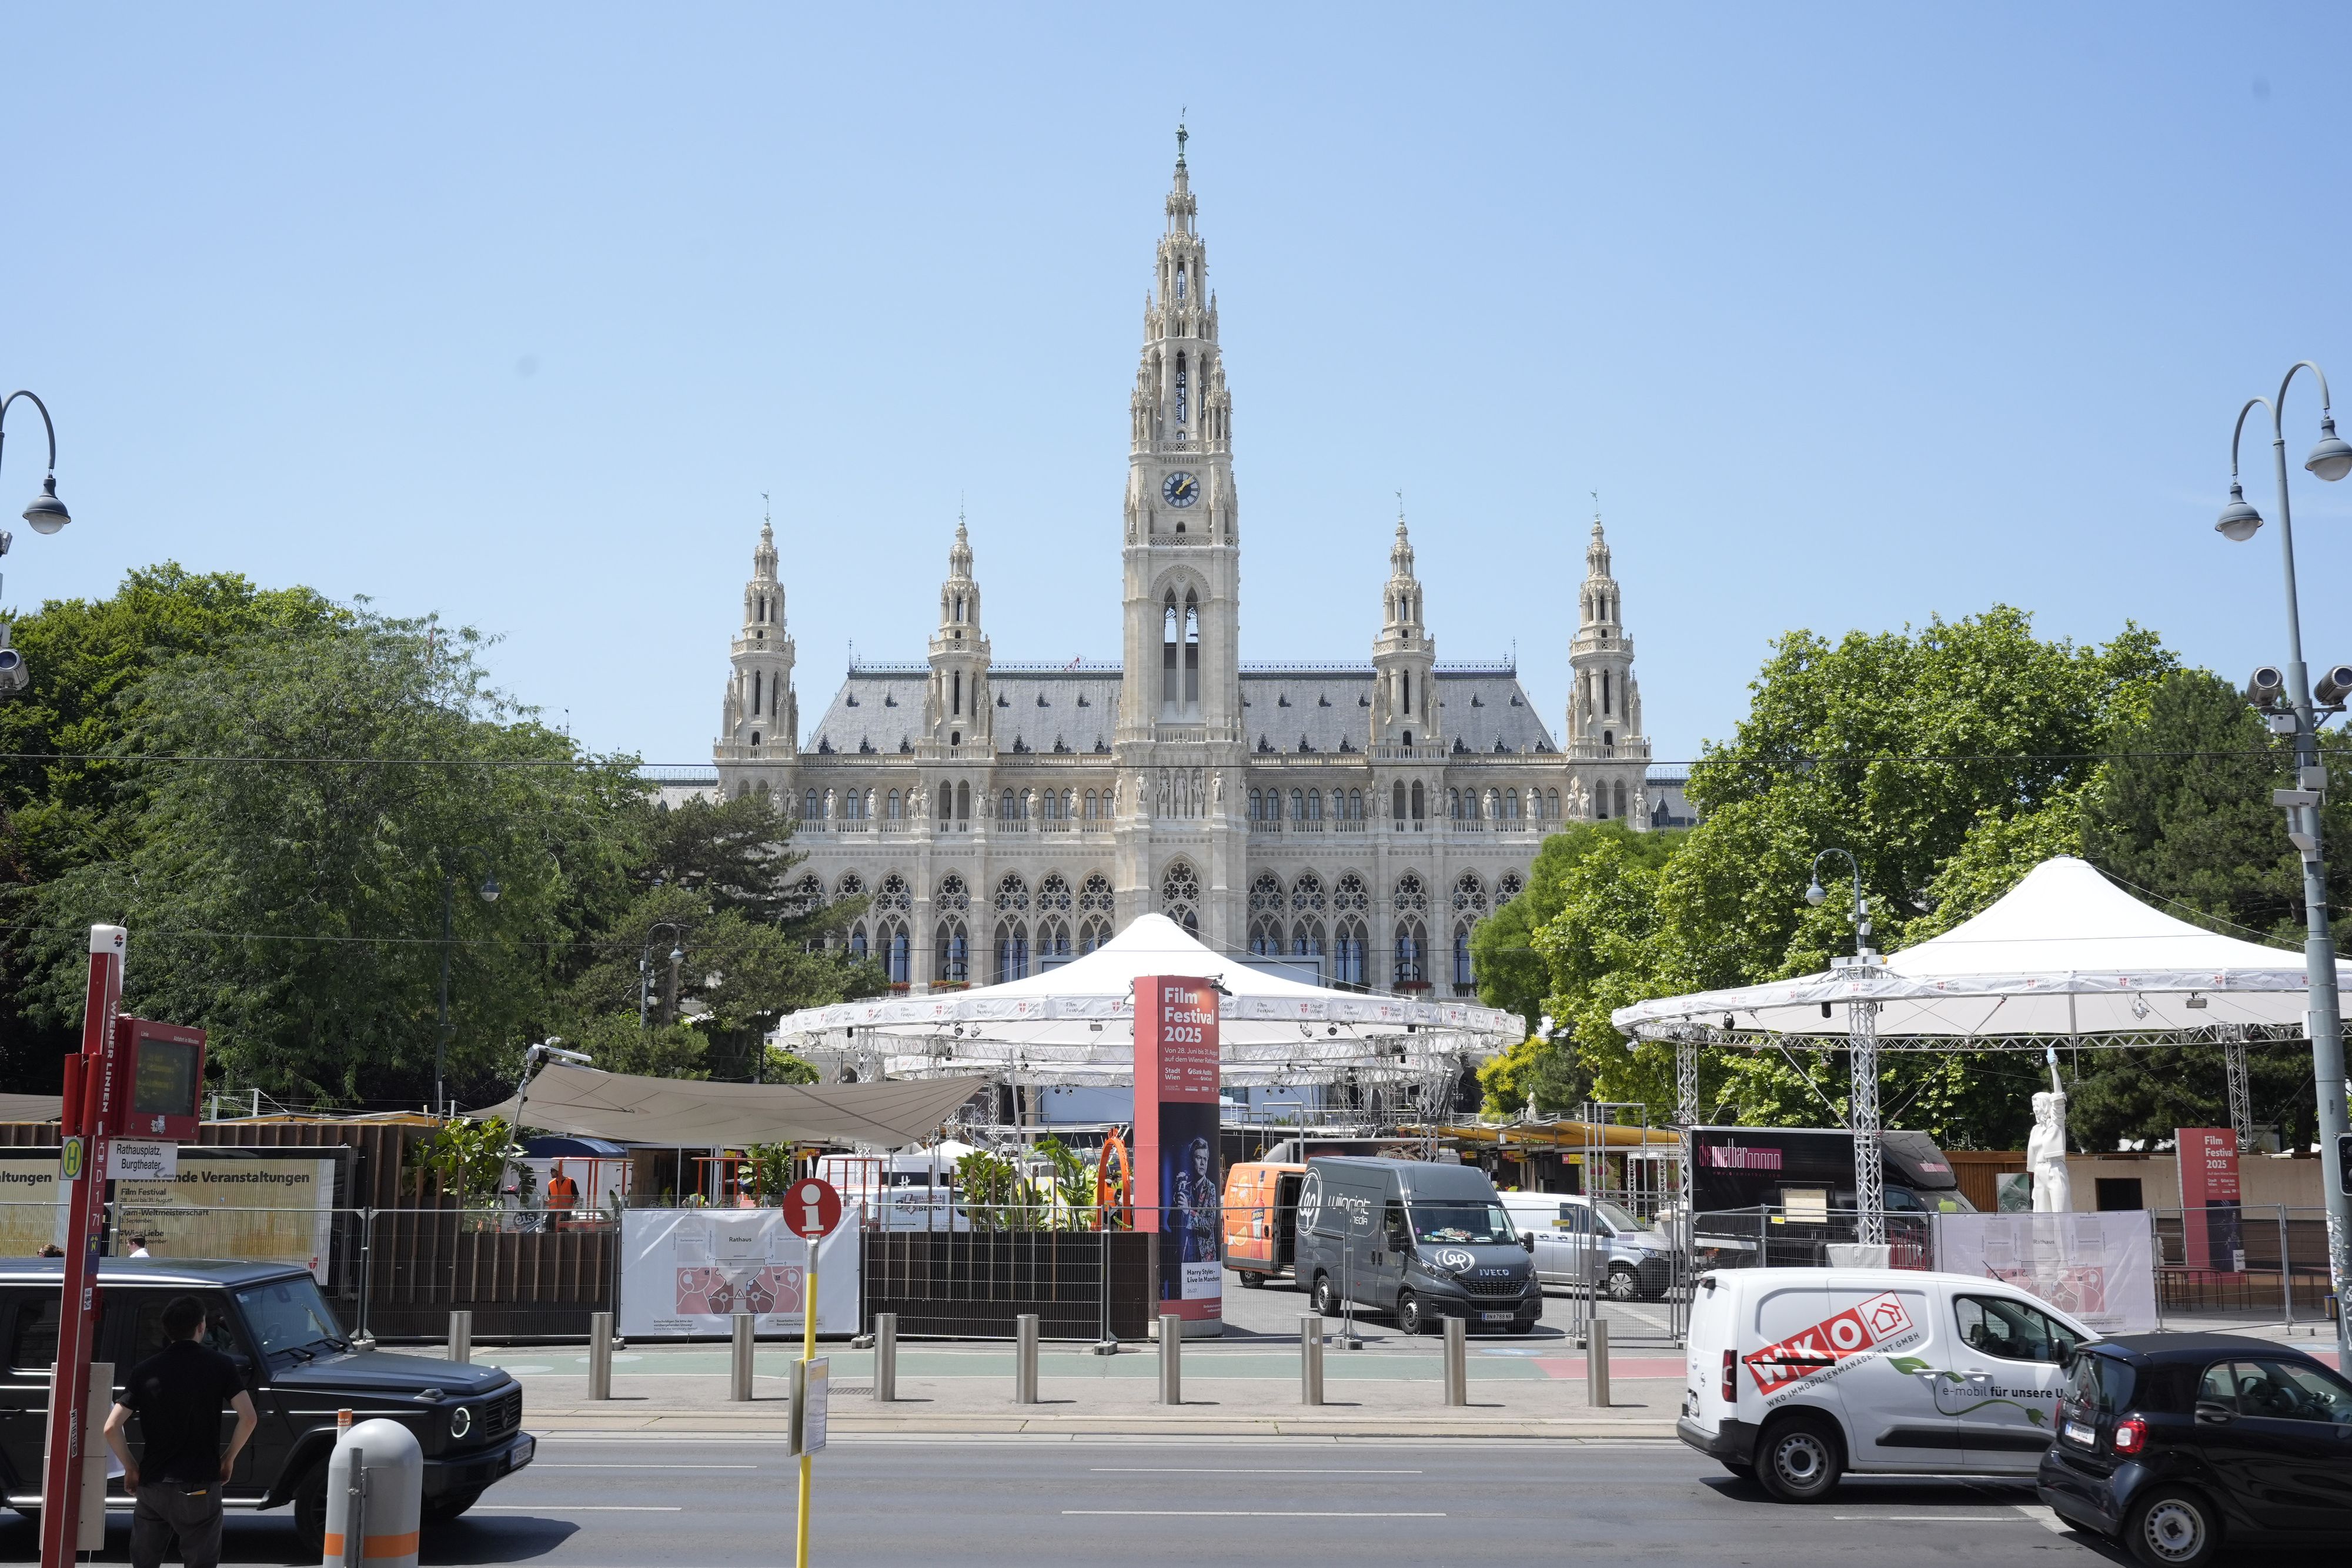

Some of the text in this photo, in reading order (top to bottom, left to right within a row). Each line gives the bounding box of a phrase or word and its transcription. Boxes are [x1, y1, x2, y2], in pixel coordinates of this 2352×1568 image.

[1165, 987, 1198, 1004] Film
[1165, 1007, 1214, 1025] Festival
[1164, 1027, 1202, 1043] 2025
[102, 1001, 117, 1112] WIENER LINIEN
[2204, 1136, 2223, 1145] Film
[116, 1144, 162, 1157] Rathausplatz,
[2205, 1148, 2233, 1157] Festival
[67, 1146, 77, 1170] H
[121, 1158, 161, 1171] Burgtheater
[2206, 1159, 2227, 1169] 2025
[96, 1169, 102, 1183] D
[201, 1171, 310, 1186] Veranstaltungen
[96, 1191, 99, 1203] 1
[92, 1213, 100, 1226] 71
[1750, 1318, 1862, 1386] WKO
[1766, 1332, 1920, 1408] WKO IMMOBILIENMANAGEMENT GMBH
[1943, 1386, 1987, 1397] e-mobil
[1990, 1386, 2009, 1397] für
[2012, 1389, 2052, 1398] unsere
